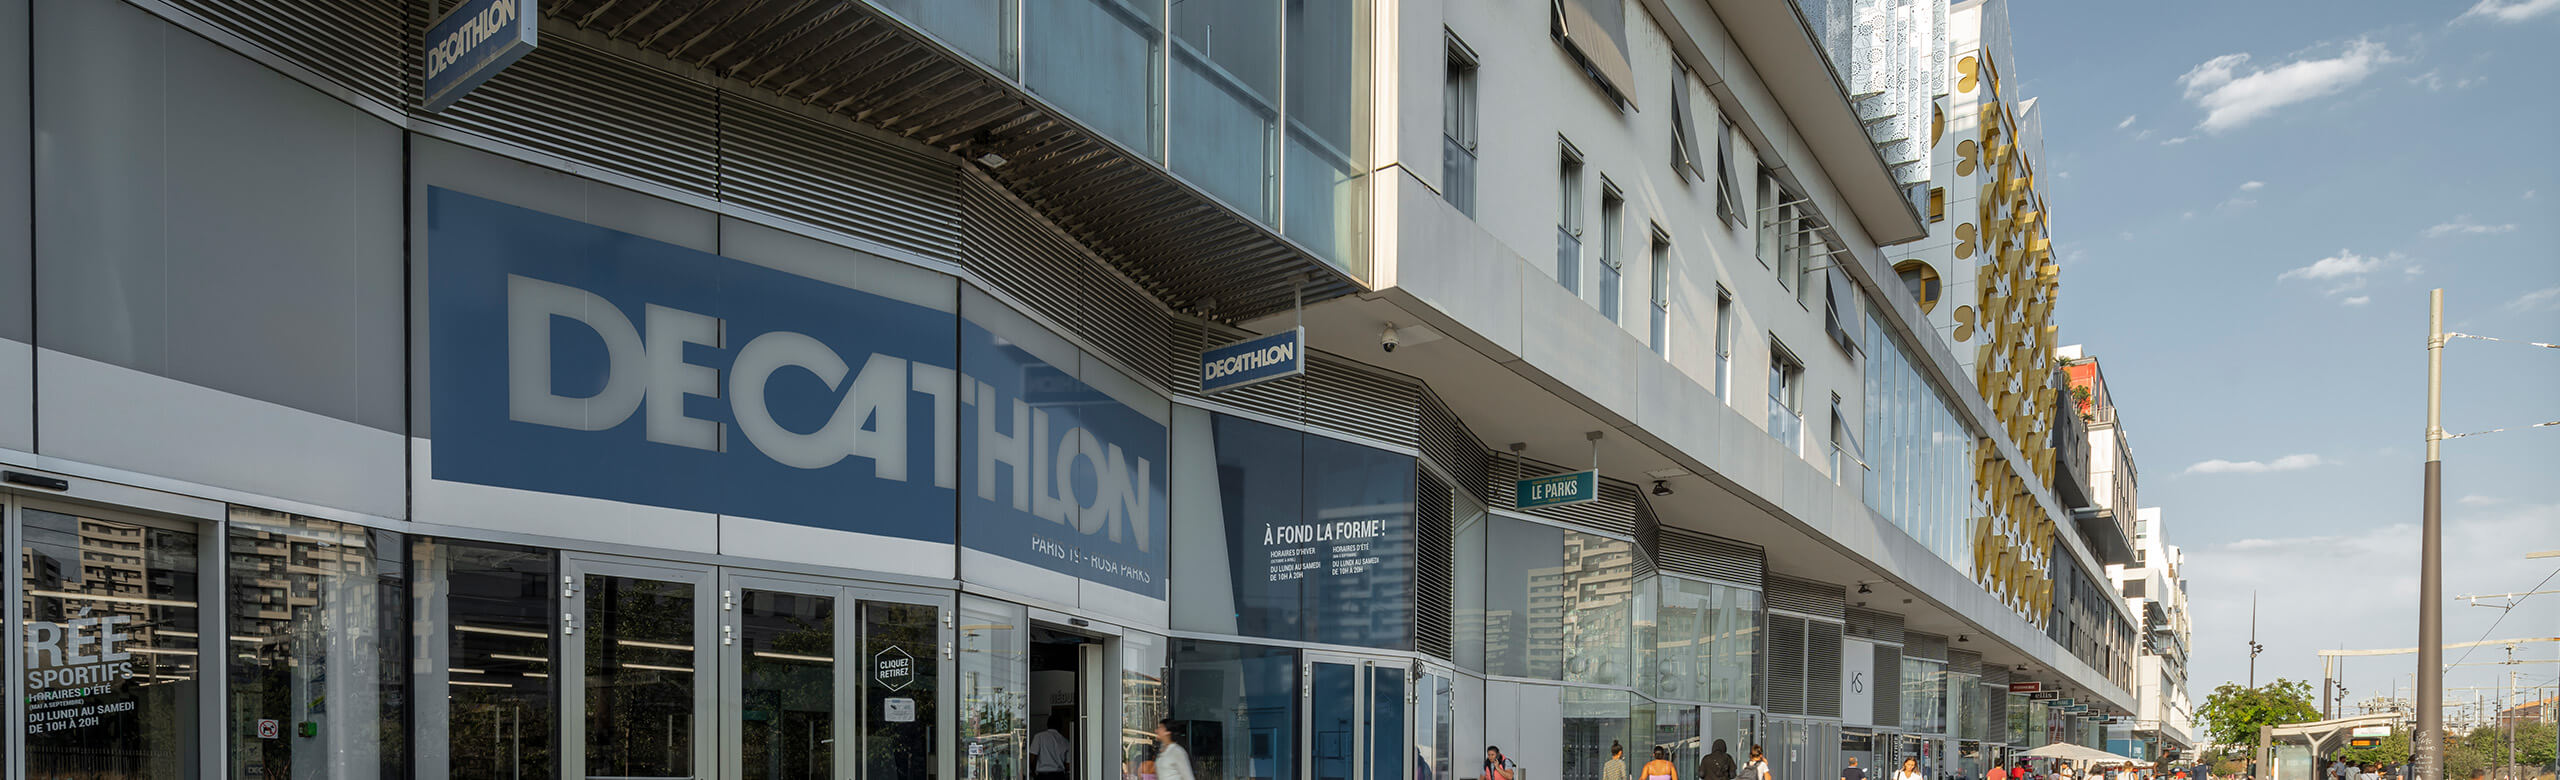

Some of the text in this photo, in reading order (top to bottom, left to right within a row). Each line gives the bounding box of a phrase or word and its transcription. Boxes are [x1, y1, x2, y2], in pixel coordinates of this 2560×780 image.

[428, 0, 516, 80] DECATHLON
[1205, 342, 1294, 380] DECATHLON
[507, 273, 1150, 553] DECATHLON
[1532, 480, 1578, 500] LE PARKS
[1264, 519, 1386, 545] À FOND LA FORME !
[1031, 534, 1066, 559] PARIS
[1270, 547, 1316, 558] HORAIRES D'HIVER
[1332, 545, 1356, 553] HORAIRES
[1270, 565, 1278, 573] DU
[1279, 564, 1294, 572] LUNDI
[1295, 563, 1302, 571] AU
[1303, 561, 1321, 570] SAMEDI
[1340, 559, 1353, 567] LUNDI
[1362, 557, 1380, 565] SAMEDI
[1332, 568, 1338, 576] DE
[27, 606, 131, 669] RÉE
[880, 658, 909, 669] CLIQUEZ
[28, 662, 134, 690] SPORTIFS
[880, 668, 909, 679] RETIREZ
[29, 683, 112, 702] HORAIRES D'ÉTÉ
[29, 701, 135, 723] DU LUNDI AU SAMEDI
[29, 716, 99, 734] DE 10H À 20H
